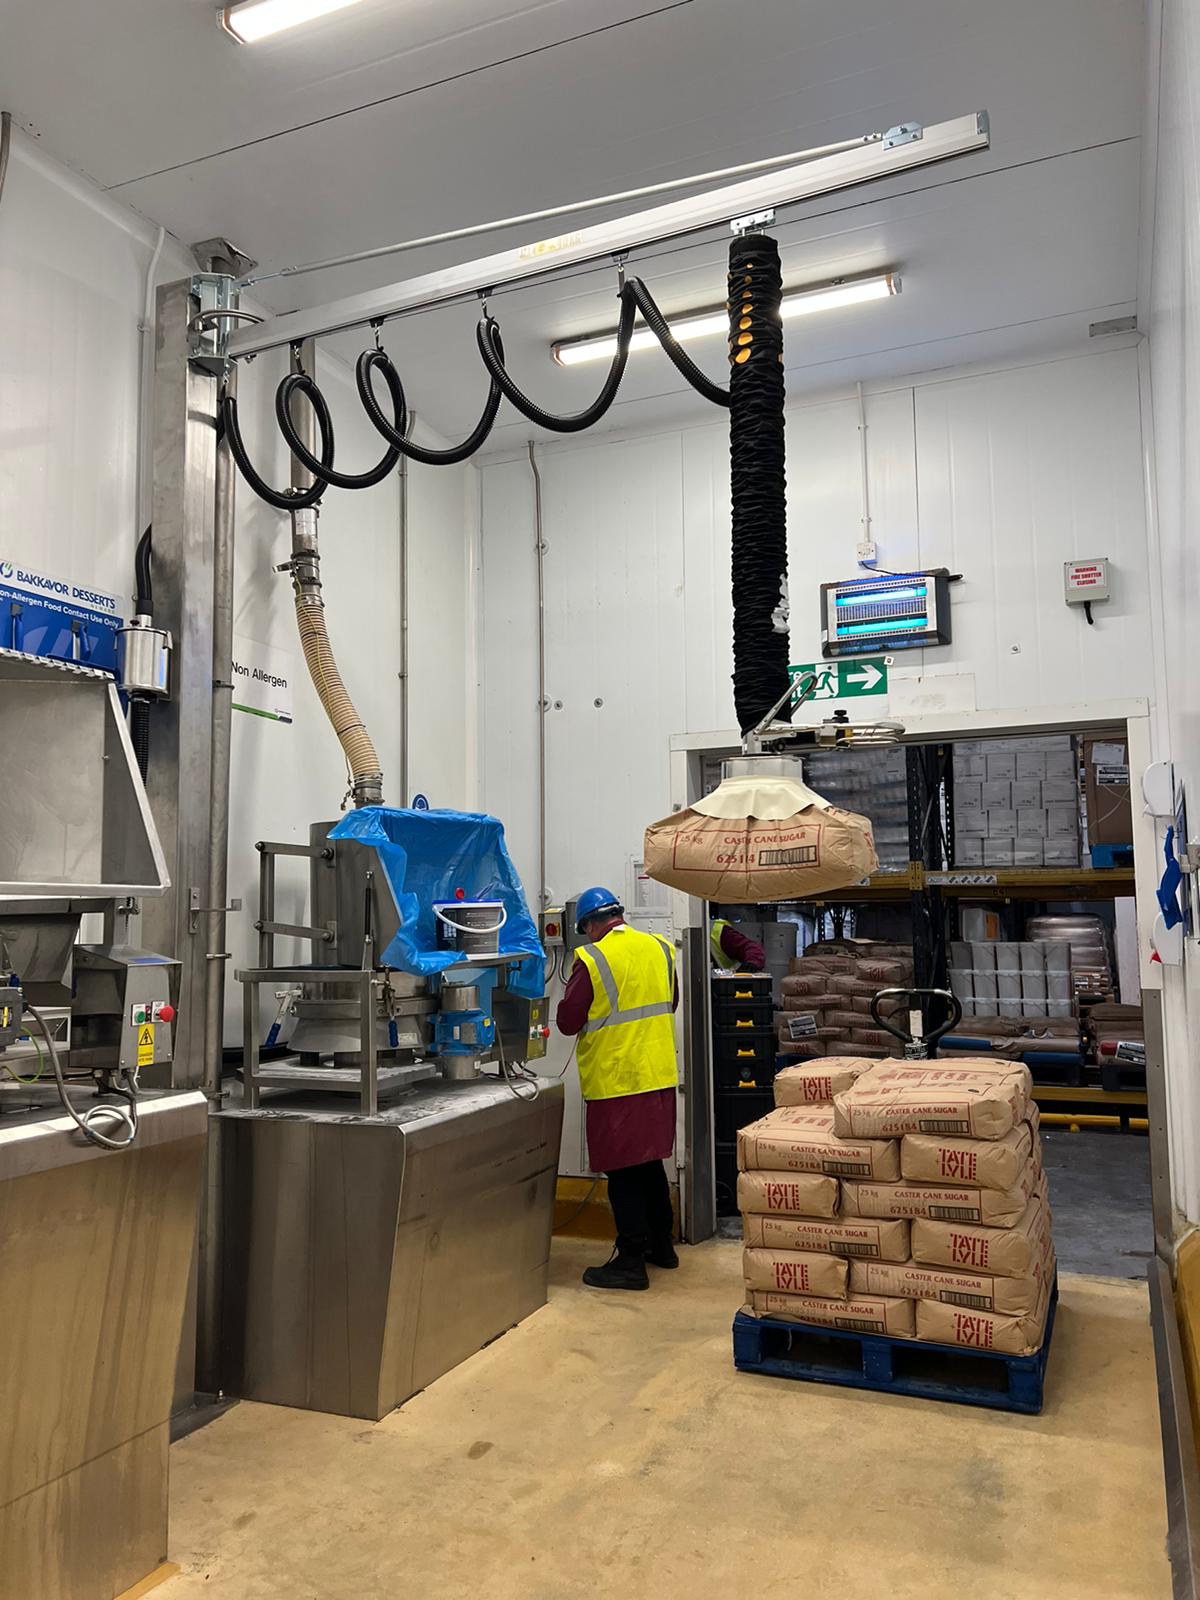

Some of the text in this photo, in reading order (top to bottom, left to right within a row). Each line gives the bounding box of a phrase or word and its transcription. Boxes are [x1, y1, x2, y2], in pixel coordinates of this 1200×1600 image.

[16, 570, 115, 609] BAKKAVOR DESSERTS
[0, 590, 42, 607] on-Allergen
[43, 600, 62, 612] Food
[63, 607, 89, 620] Contact
[104, 618, 119, 630] Only
[232, 661, 287, 688] Non Allergen
[754, 835, 778, 844] CANE
[779, 832, 806, 843] SUGAR
[716, 854, 755, 864] 62514
[800, 1077, 831, 1089] TATE
[804, 1088, 834, 1100] LYLE
[882, 1123, 918, 1132] 625184
[791, 1145, 816, 1154] CASTER
[818, 1148, 836, 1156] CANE
[837, 1149, 861, 1157] SUGAR
[939, 1148, 977, 1166] TATE
[788, 1160, 821, 1169] 625184
[941, 1163, 977, 1180] LYLE
[764, 1183, 799, 1198] TATE
[870, 1190, 879, 1198] kg
[894, 1191, 920, 1199] CASTER
[944, 1193, 969, 1201] SUGAR
[767, 1197, 800, 1211] LYLE
[890, 1206, 926, 1215] 625184
[774, 1223, 782, 1231] kg
[797, 1225, 822, 1234] CASTER
[824, 1228, 842, 1236] CANE
[844, 1229, 868, 1238] SUGAR
[795, 1241, 827, 1250] 625184
[950, 1233, 988, 1253] TATE
[952, 1249, 988, 1268] LYLE
[773, 1262, 808, 1278] TATE
[776, 1277, 809, 1291] LYLE
[880, 1269, 889, 1278] kg
[905, 1272, 932, 1282] CASTER
[934, 1276, 954, 1284] CANE
[956, 1278, 981, 1288] SUGAR
[769, 1295, 778, 1303] 25
[802, 1301, 828, 1310] CASTER
[850, 1306, 874, 1315] SUGAR
[954, 1313, 993, 1334] TATE
[957, 1329, 993, 1348] LYLE
